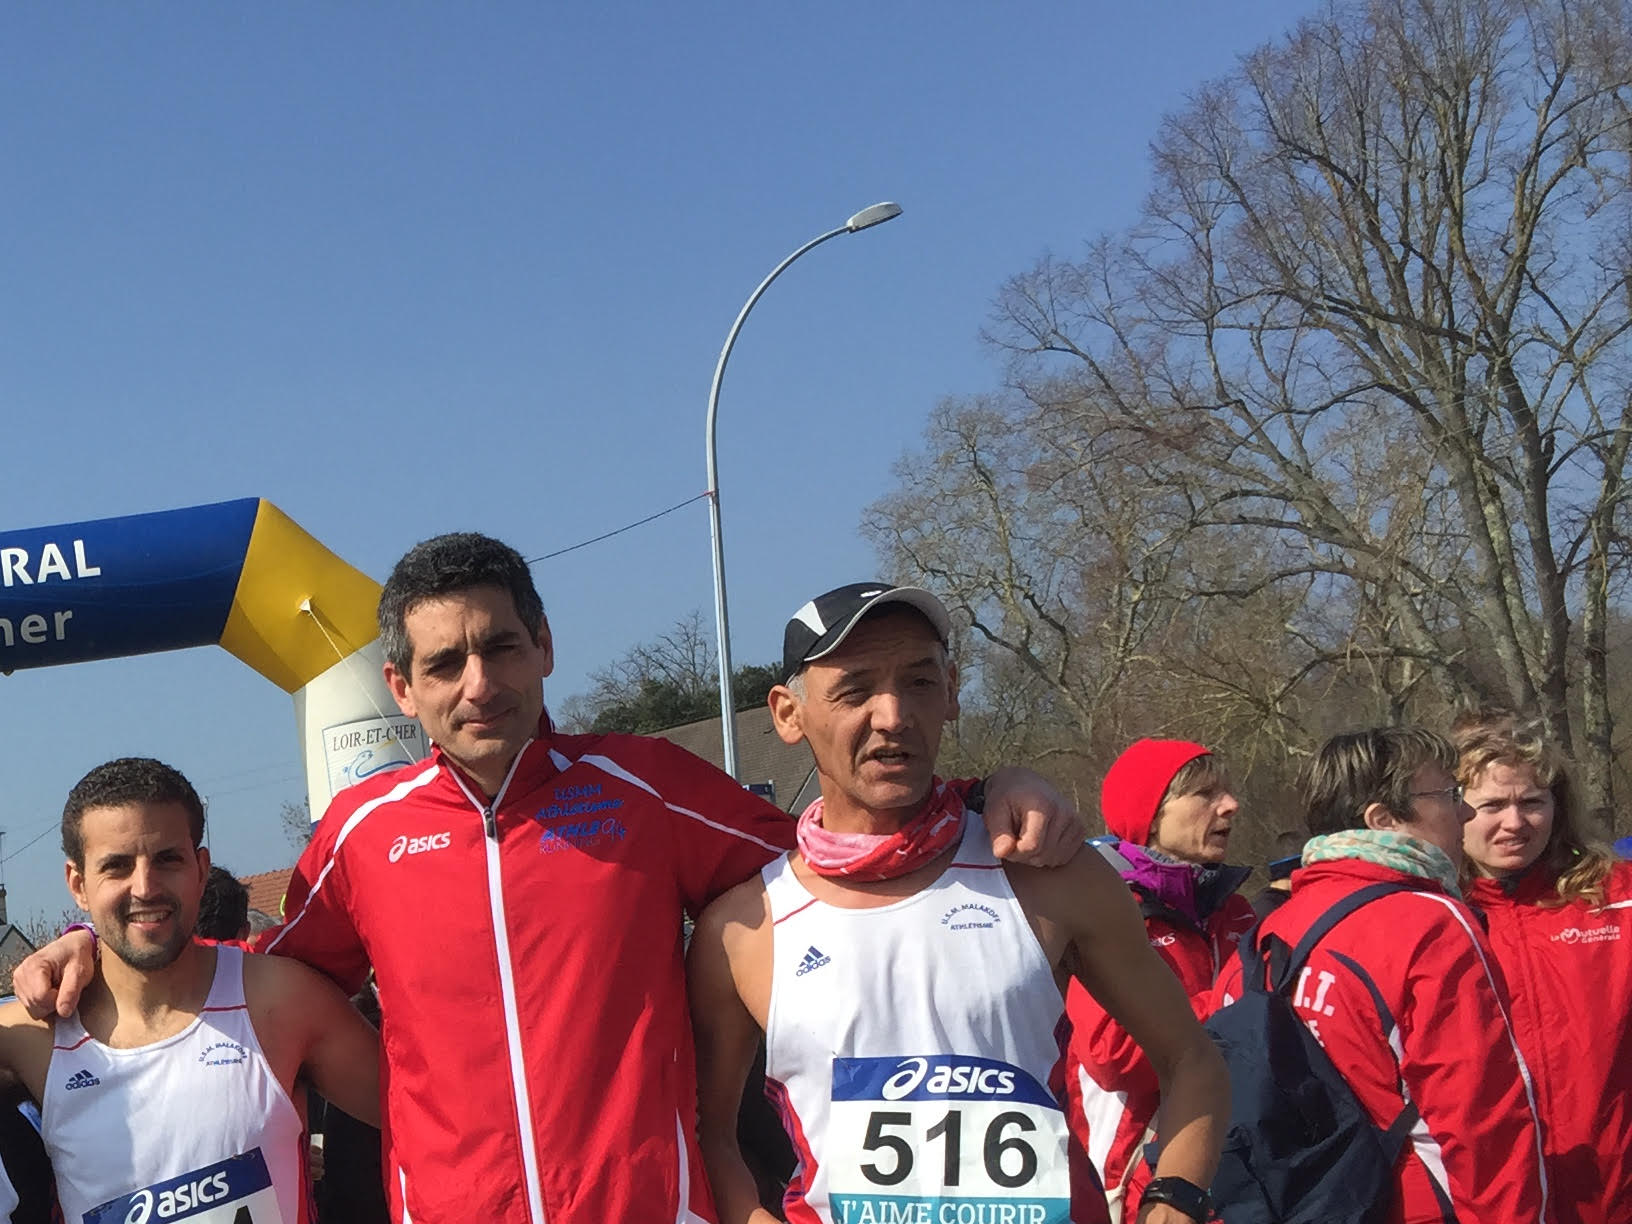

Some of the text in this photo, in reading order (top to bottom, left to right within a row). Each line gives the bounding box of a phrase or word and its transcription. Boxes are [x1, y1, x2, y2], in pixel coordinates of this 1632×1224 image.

[332, 724, 417, 752] LOIR-ET-CHER
[407, 831, 452, 855] asics
[795, 954, 832, 978] adidas
[65, 1077, 101, 1091] adidas
[925, 1065, 1016, 1095] asics
[859, 1109, 1038, 1189] 516
[157, 1170, 230, 1219] asics
